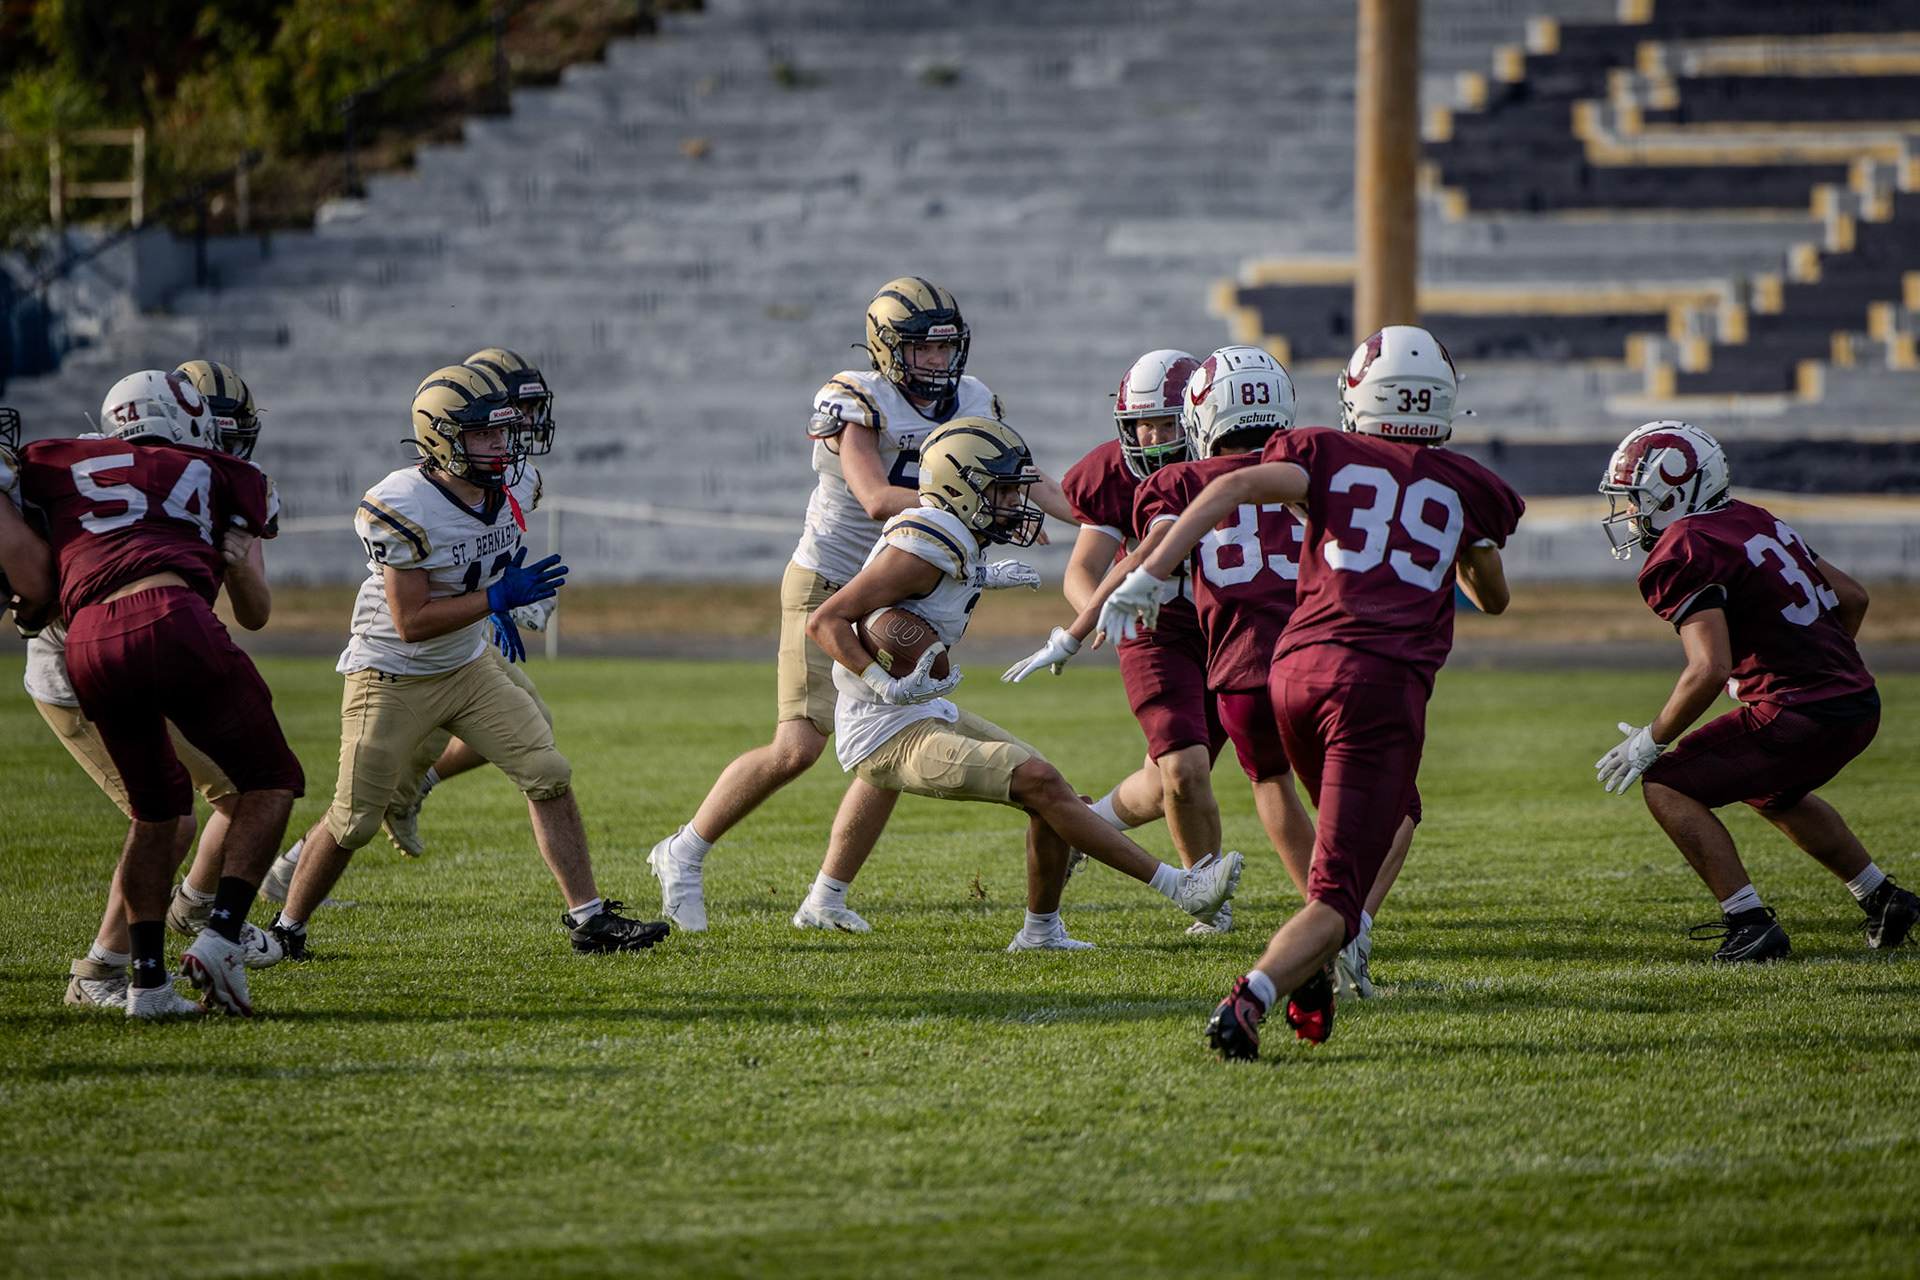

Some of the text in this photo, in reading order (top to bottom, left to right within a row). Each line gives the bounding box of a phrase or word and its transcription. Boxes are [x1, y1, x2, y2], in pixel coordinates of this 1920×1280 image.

[1241, 382, 1270, 405] 83
[114, 401, 140, 428] 54
[1131, 402, 1156, 410] Riddell
[1238, 411, 1276, 425] schutt
[1380, 422, 1439, 436] Riddell
[70, 453, 214, 546] 54
[1324, 462, 1464, 593] 39
[363, 536, 388, 565] 12
[452, 542, 471, 566] ST.
